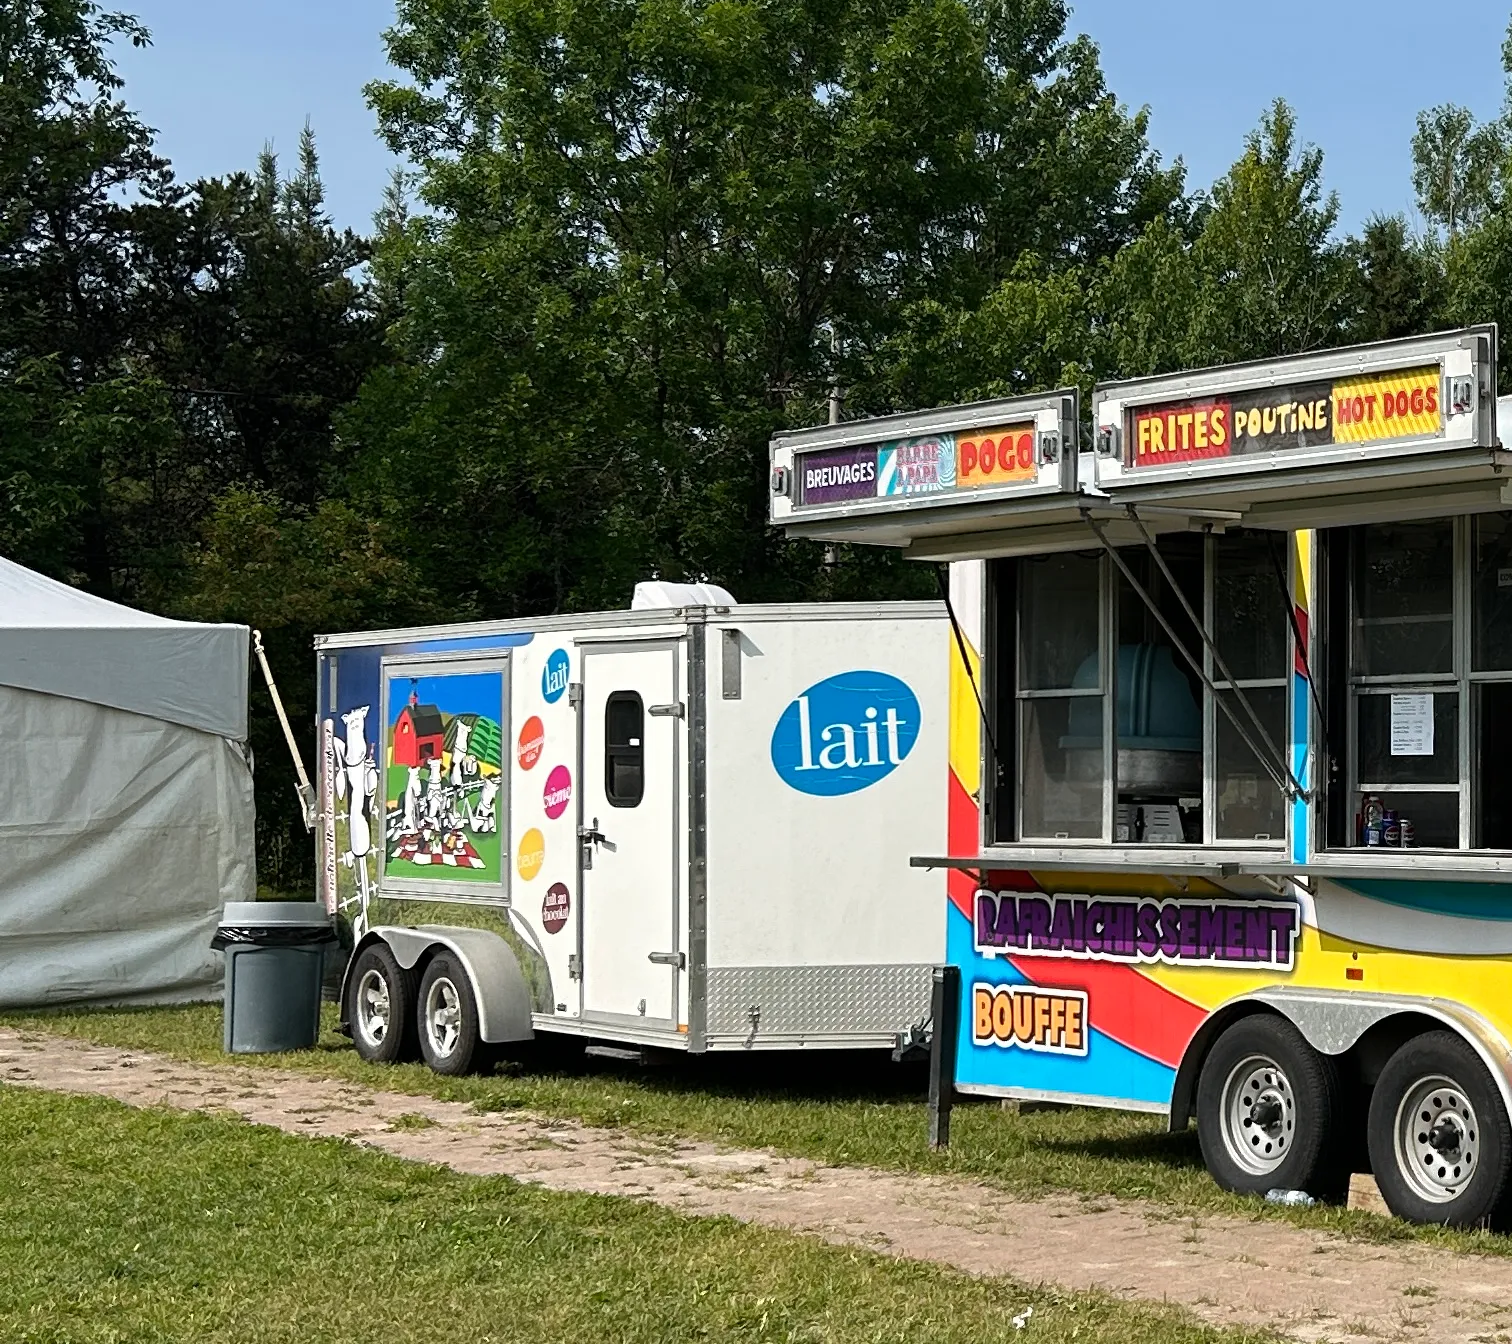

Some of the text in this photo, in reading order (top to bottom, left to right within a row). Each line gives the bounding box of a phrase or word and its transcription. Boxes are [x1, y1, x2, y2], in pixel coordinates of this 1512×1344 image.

[1338, 386, 1438, 425] HOT DOGS
[1138, 408, 1228, 455] FRITES
[806, 462, 875, 490] BREUVAGES
[961, 433, 1034, 477] POGO
[545, 662, 568, 695] lait
[795, 696, 907, 771] lait
[977, 895, 1296, 964] RAFRAICHISSEMENT
[975, 989, 1084, 1048] BOUFFE
